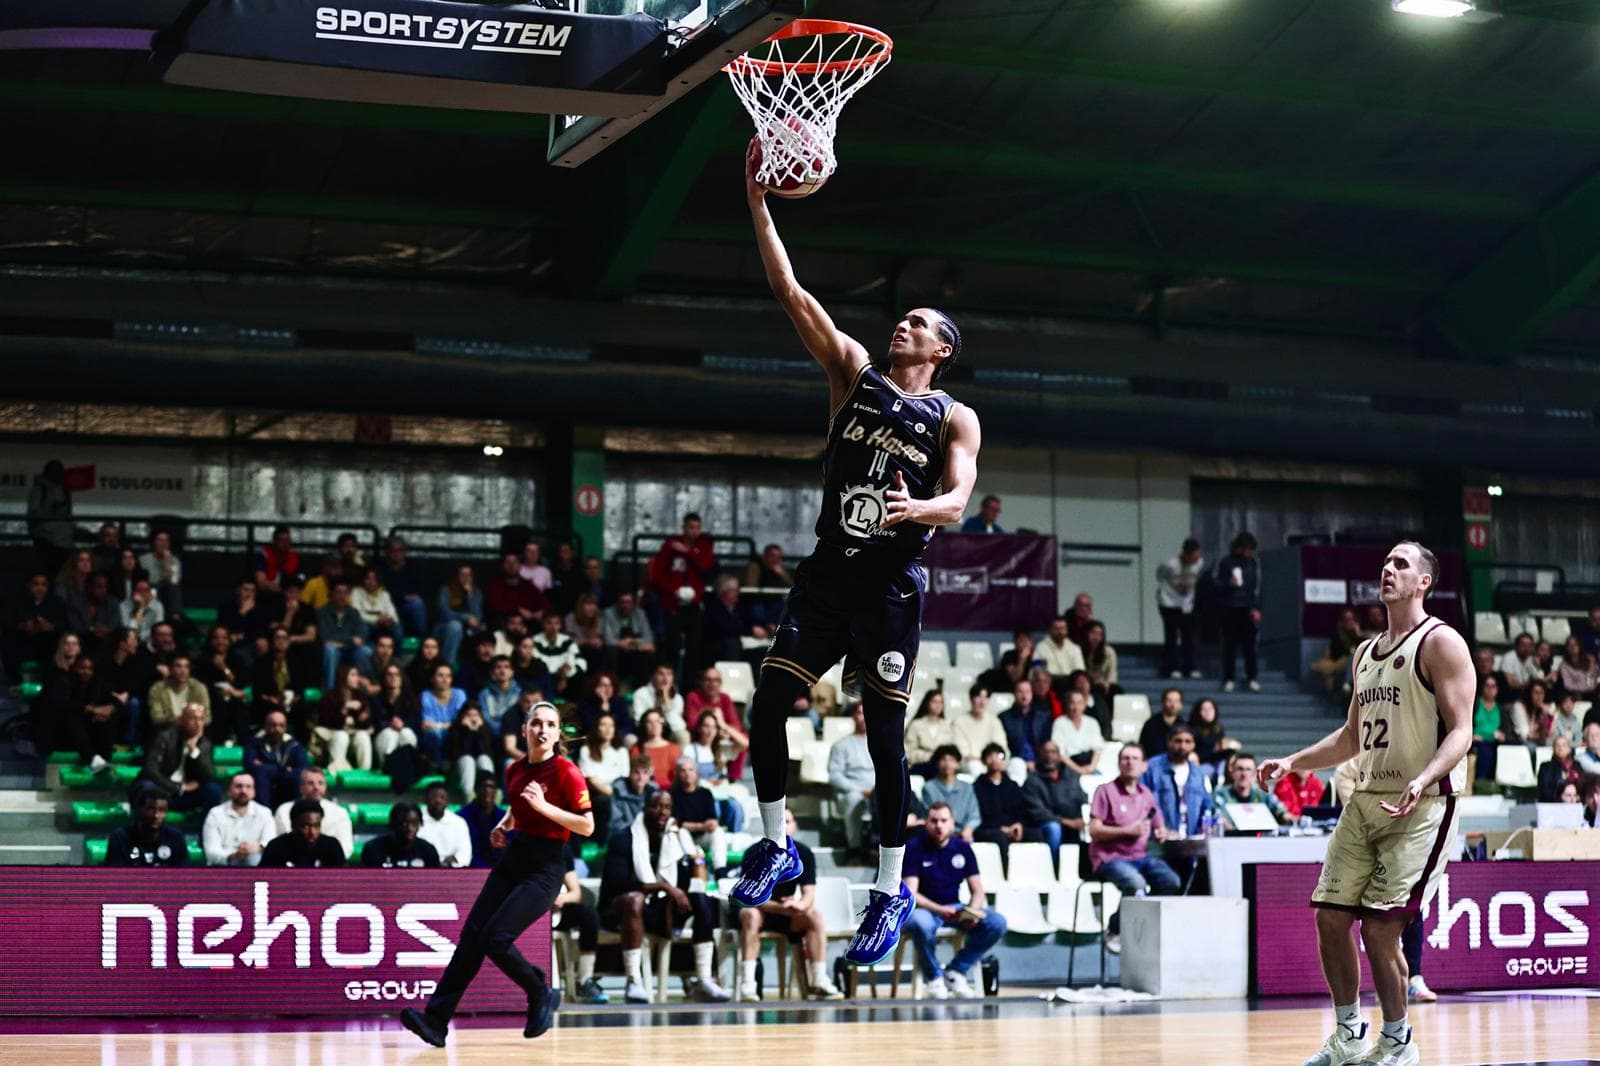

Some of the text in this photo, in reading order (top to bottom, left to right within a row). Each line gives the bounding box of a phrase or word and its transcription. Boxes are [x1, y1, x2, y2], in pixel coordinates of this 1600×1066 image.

[315, 7, 572, 50] SPORTSYSTEM
[842, 416, 865, 441] Le
[867, 449, 890, 480] 14
[99, 475, 184, 491] TOULOUSE
[1356, 686, 1401, 707] OULOUSE
[1362, 718, 1390, 751] 22
[101, 881, 460, 968] nehos
[1421, 872, 1590, 950] hos
[1505, 956, 1589, 976] GROUPE
[344, 980, 436, 1000] GROUP
